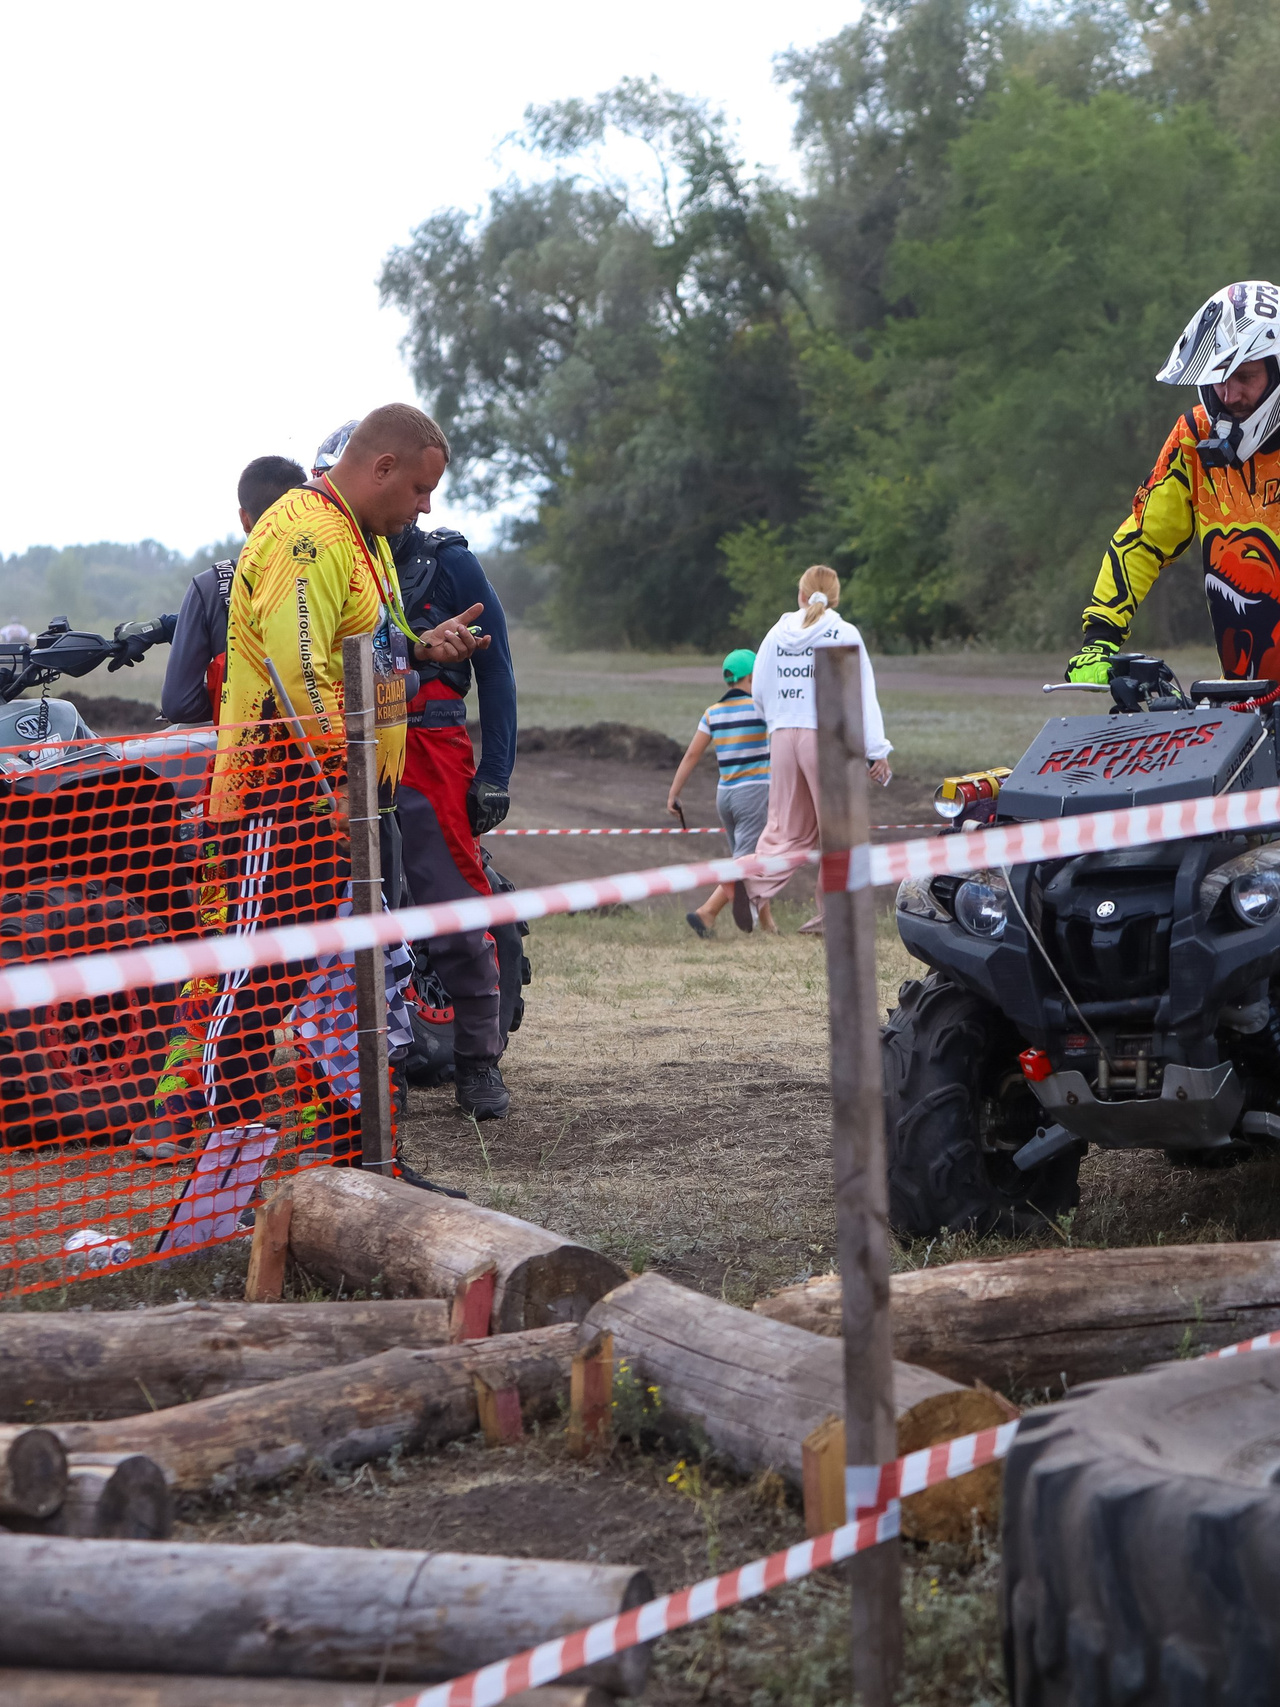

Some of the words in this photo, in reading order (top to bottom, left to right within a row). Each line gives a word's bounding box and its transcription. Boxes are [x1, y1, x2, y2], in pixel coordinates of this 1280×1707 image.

[1254, 285, 1279, 319] 073
[296, 578, 332, 734] kvadroclubsamara.ru
[1037, 721, 1223, 775] RAPTORS
[1103, 750, 1183, 780] URAL
